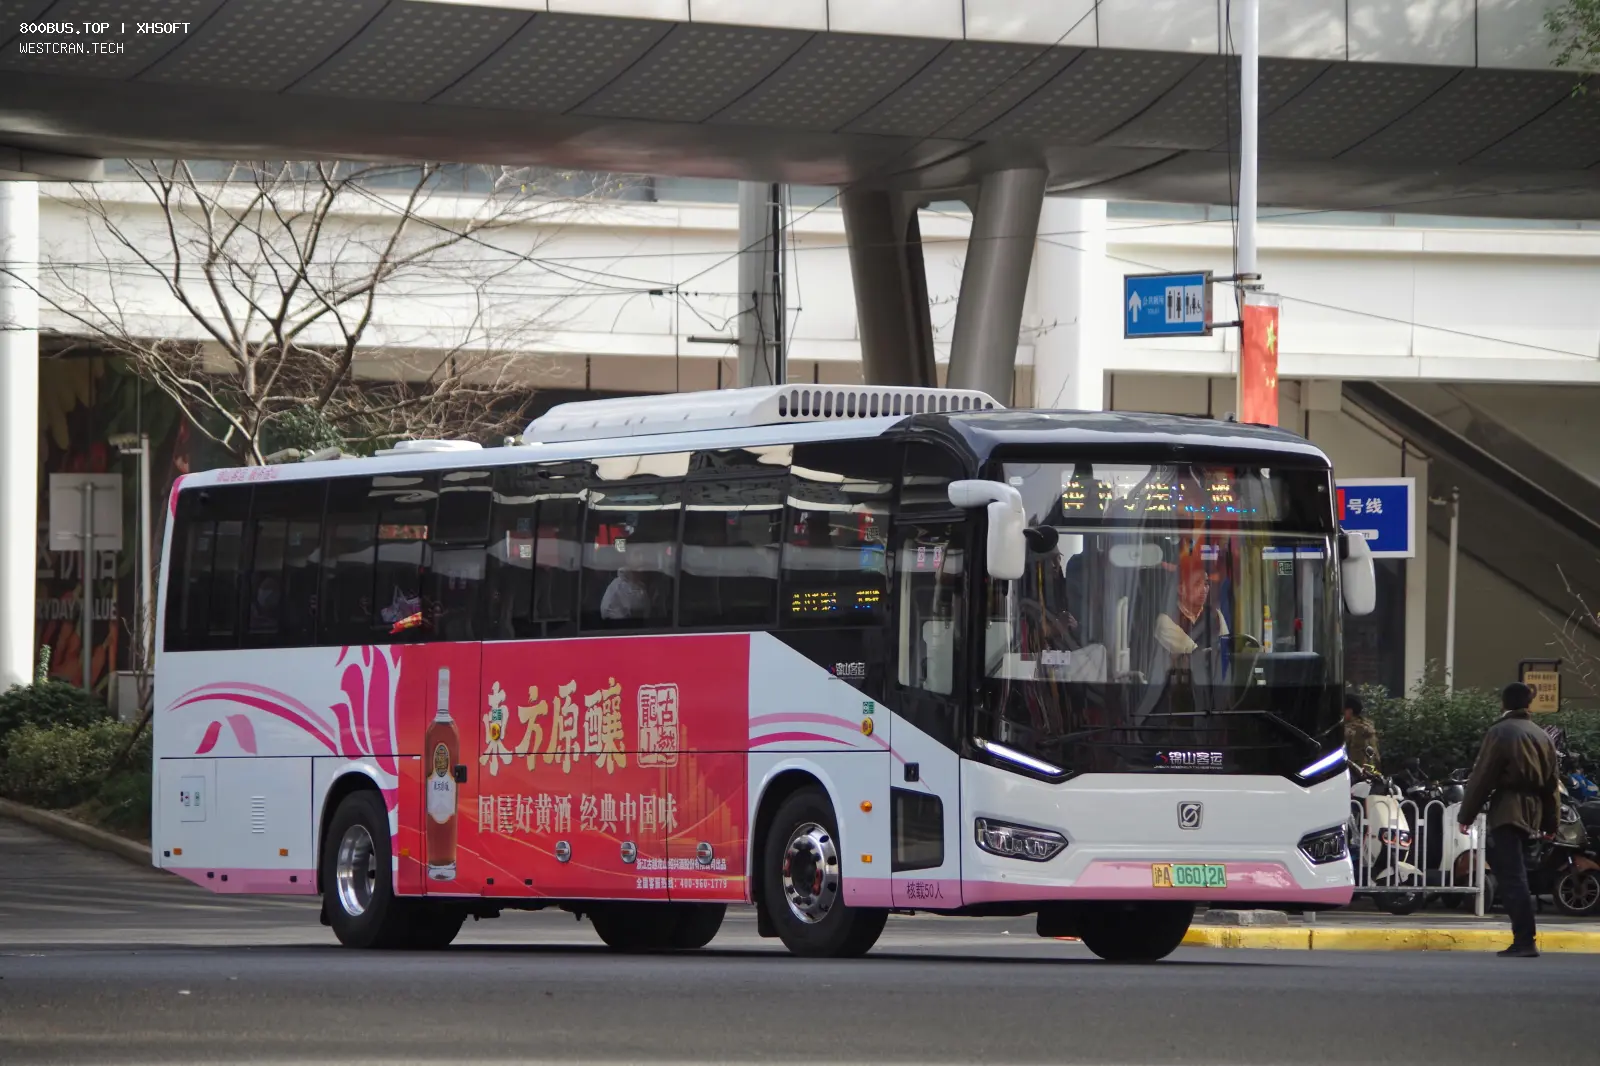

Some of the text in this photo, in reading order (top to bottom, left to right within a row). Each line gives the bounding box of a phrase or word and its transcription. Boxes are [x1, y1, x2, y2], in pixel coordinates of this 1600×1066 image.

[1168, 751, 1223, 766] 锦山客运
[580, 793, 678, 834] 经典中国味
[907, 882, 944, 899] 核载50人
